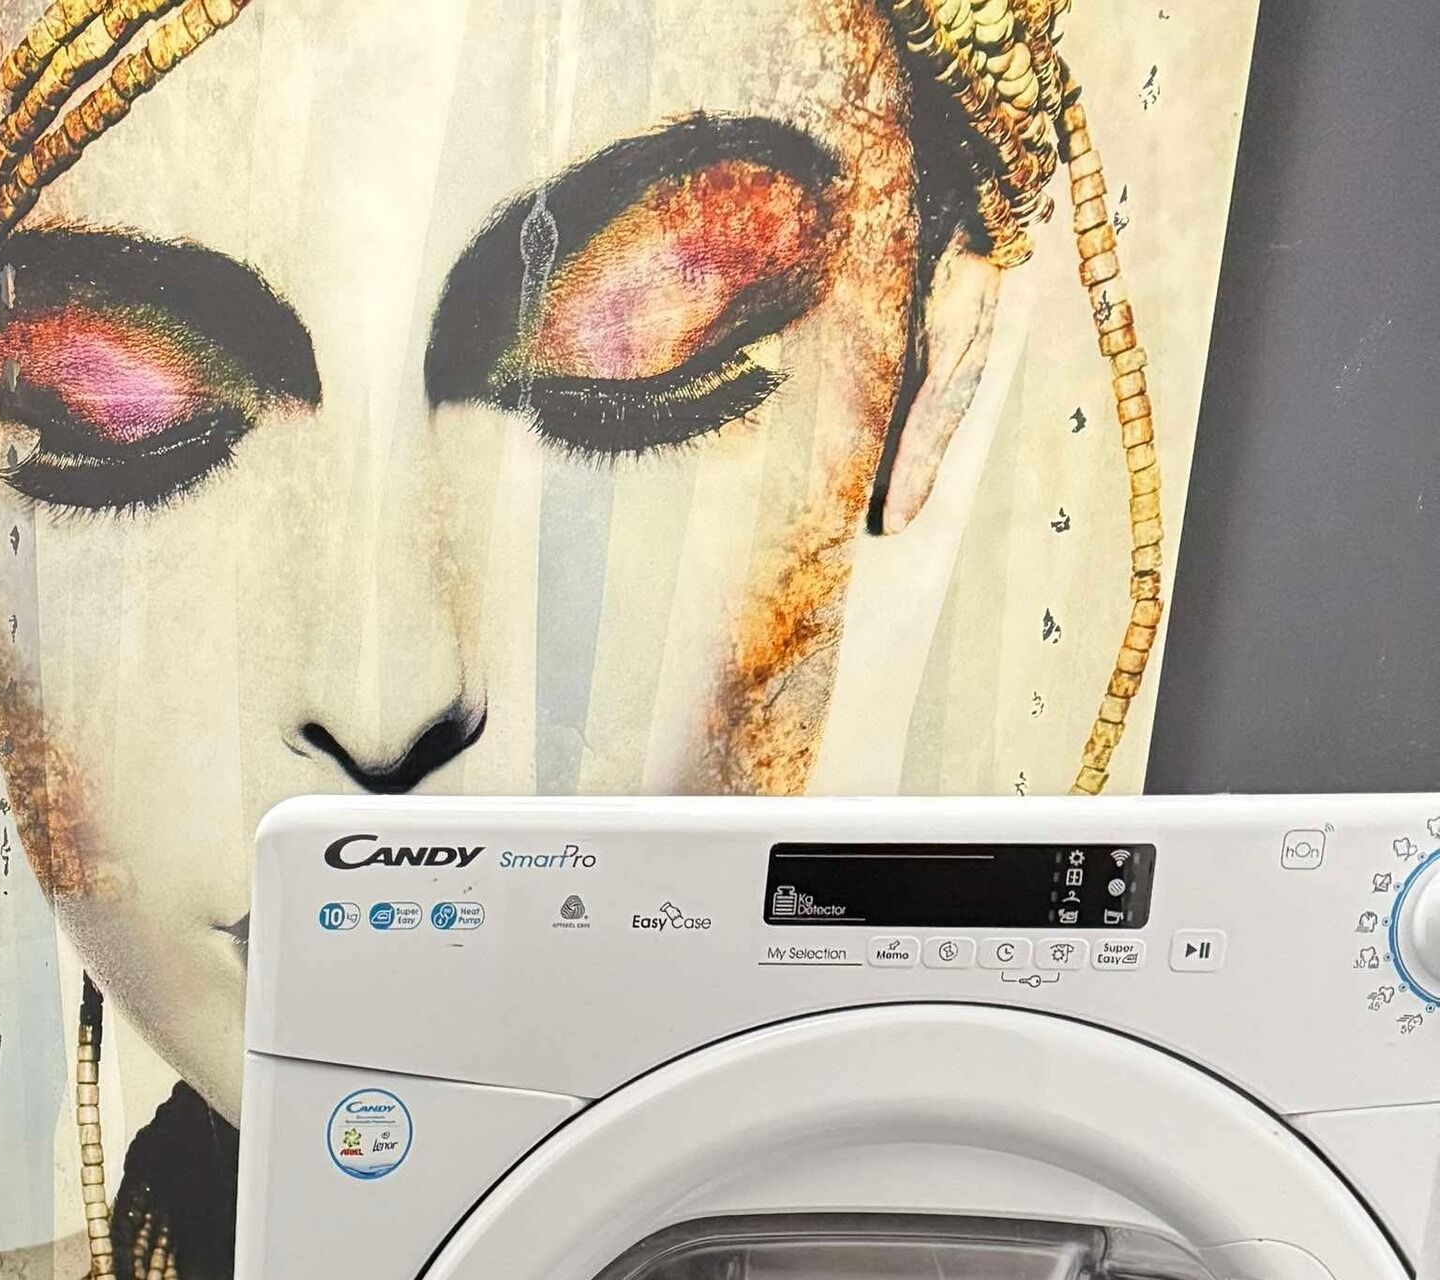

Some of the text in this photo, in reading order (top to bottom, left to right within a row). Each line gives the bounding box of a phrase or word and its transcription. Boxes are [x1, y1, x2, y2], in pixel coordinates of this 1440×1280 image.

[324, 834, 486, 869] CANDY
[322, 908, 342, 926] 10
[797, 905, 846, 916] Detector
[767, 946, 847, 961] My Selection
[1103, 943, 1134, 955] Super
[1097, 953, 1122, 966] Easy
[346, 1101, 396, 1113] CANDY
